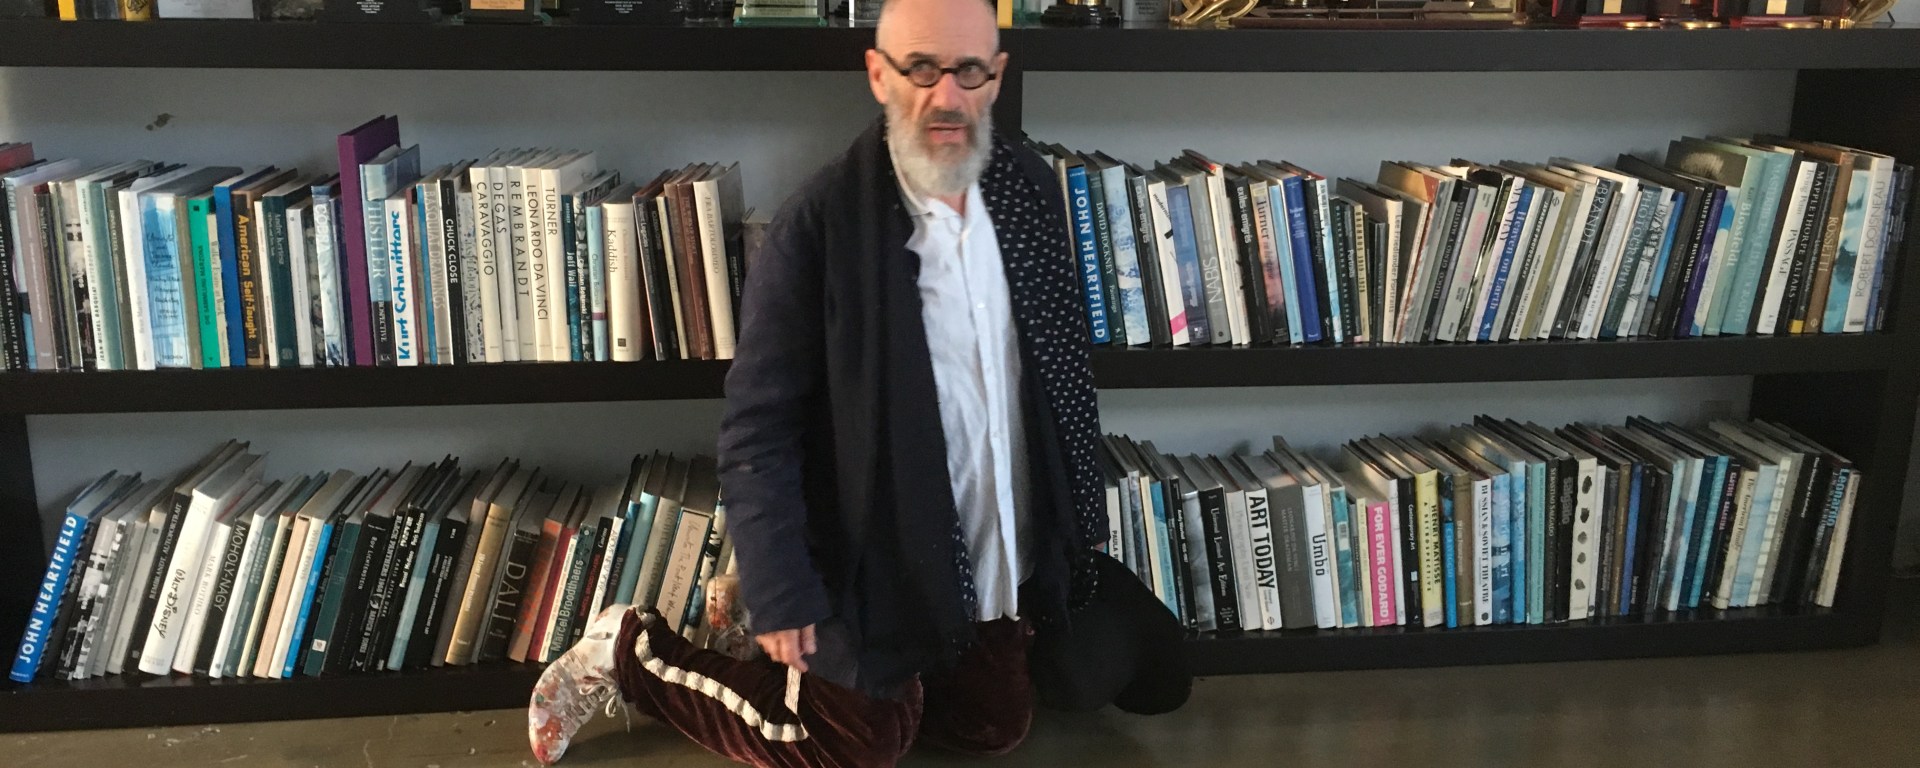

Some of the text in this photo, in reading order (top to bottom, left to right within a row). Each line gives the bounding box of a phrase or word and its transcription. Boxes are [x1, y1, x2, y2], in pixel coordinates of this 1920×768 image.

[315, 204, 330, 253] COBRA
[476, 182, 494, 276] CARAVAGGIO
[493, 183, 506, 233] DEGAS
[545, 188, 557, 235] TURNER
[1256, 200, 1271, 240] Turner
[1535, 201, 1549, 232] JAPANESE
[1580, 187, 1608, 245] BRANDT
[1778, 169, 1814, 277] Irving Penn PASSAGE
[425, 190, 445, 309] BASQUIAT DRAWINGS
[445, 219, 458, 283] CHUCK CLOSE
[510, 181, 529, 297] REMBRANDT
[527, 185, 548, 320] LEONARDO DA VINCI
[567, 252, 576, 267] Jeff
[607, 229, 617, 273] Kaddish
[1096, 202, 1106, 230] DAVID
[1101, 232, 1113, 275] HOCKNEY
[1521, 234, 1539, 279] PHOTOGRAPHY
[1616, 190, 1653, 291] PHOTOGRAPHY
[1726, 202, 1752, 267] Blossfeldt
[1788, 171, 1825, 298] MAPPLETHORPE ALTARS
[1818, 216, 1839, 272] ROSSETTI
[1855, 181, 1886, 297] ROBERT DOISNEAU
[238, 215, 256, 338] American Self-Taught
[1074, 188, 1105, 339] JOHN HEARTFIELD
[1202, 257, 1222, 303] NABIS
[1347, 250, 1355, 278] Portraits
[1388, 214, 1402, 313] Lee Friedlander Portraits
[1490, 210, 1526, 310] Heaven on Earth
[579, 286, 587, 314] Boltanski
[398, 318, 410, 359] Kurt
[1280, 509, 1288, 532] MASTER
[1548, 505, 1556, 536] SALGADO
[1561, 477, 1572, 525] salgado
[1826, 468, 1850, 527] Leonardo
[162, 502, 183, 554] AUTOPORTRAIT
[389, 515, 403, 539] BLACK
[1235, 510, 1248, 560] Photography
[1248, 497, 1275, 589] ART TODAY
[1287, 508, 1296, 542] LEONARDO
[213, 525, 246, 611] MOHOLY-NAGY
[379, 540, 396, 577] PANTHERS
[610, 557, 624, 586] BOSCH
[1216, 562, 1226, 572] Art
[1312, 533, 1327, 576] Umbo
[1374, 507, 1389, 618] FOR EVER GODARD
[1432, 541, 1441, 584] MATISSE
[19, 516, 78, 664] JOHN HEARTFIELD
[376, 578, 387, 593] 1968
[559, 560, 584, 617] Broodthaers
[1219, 575, 1228, 596] Editions
[1481, 565, 1489, 604] THEATRE
[551, 618, 568, 651] Marcel
